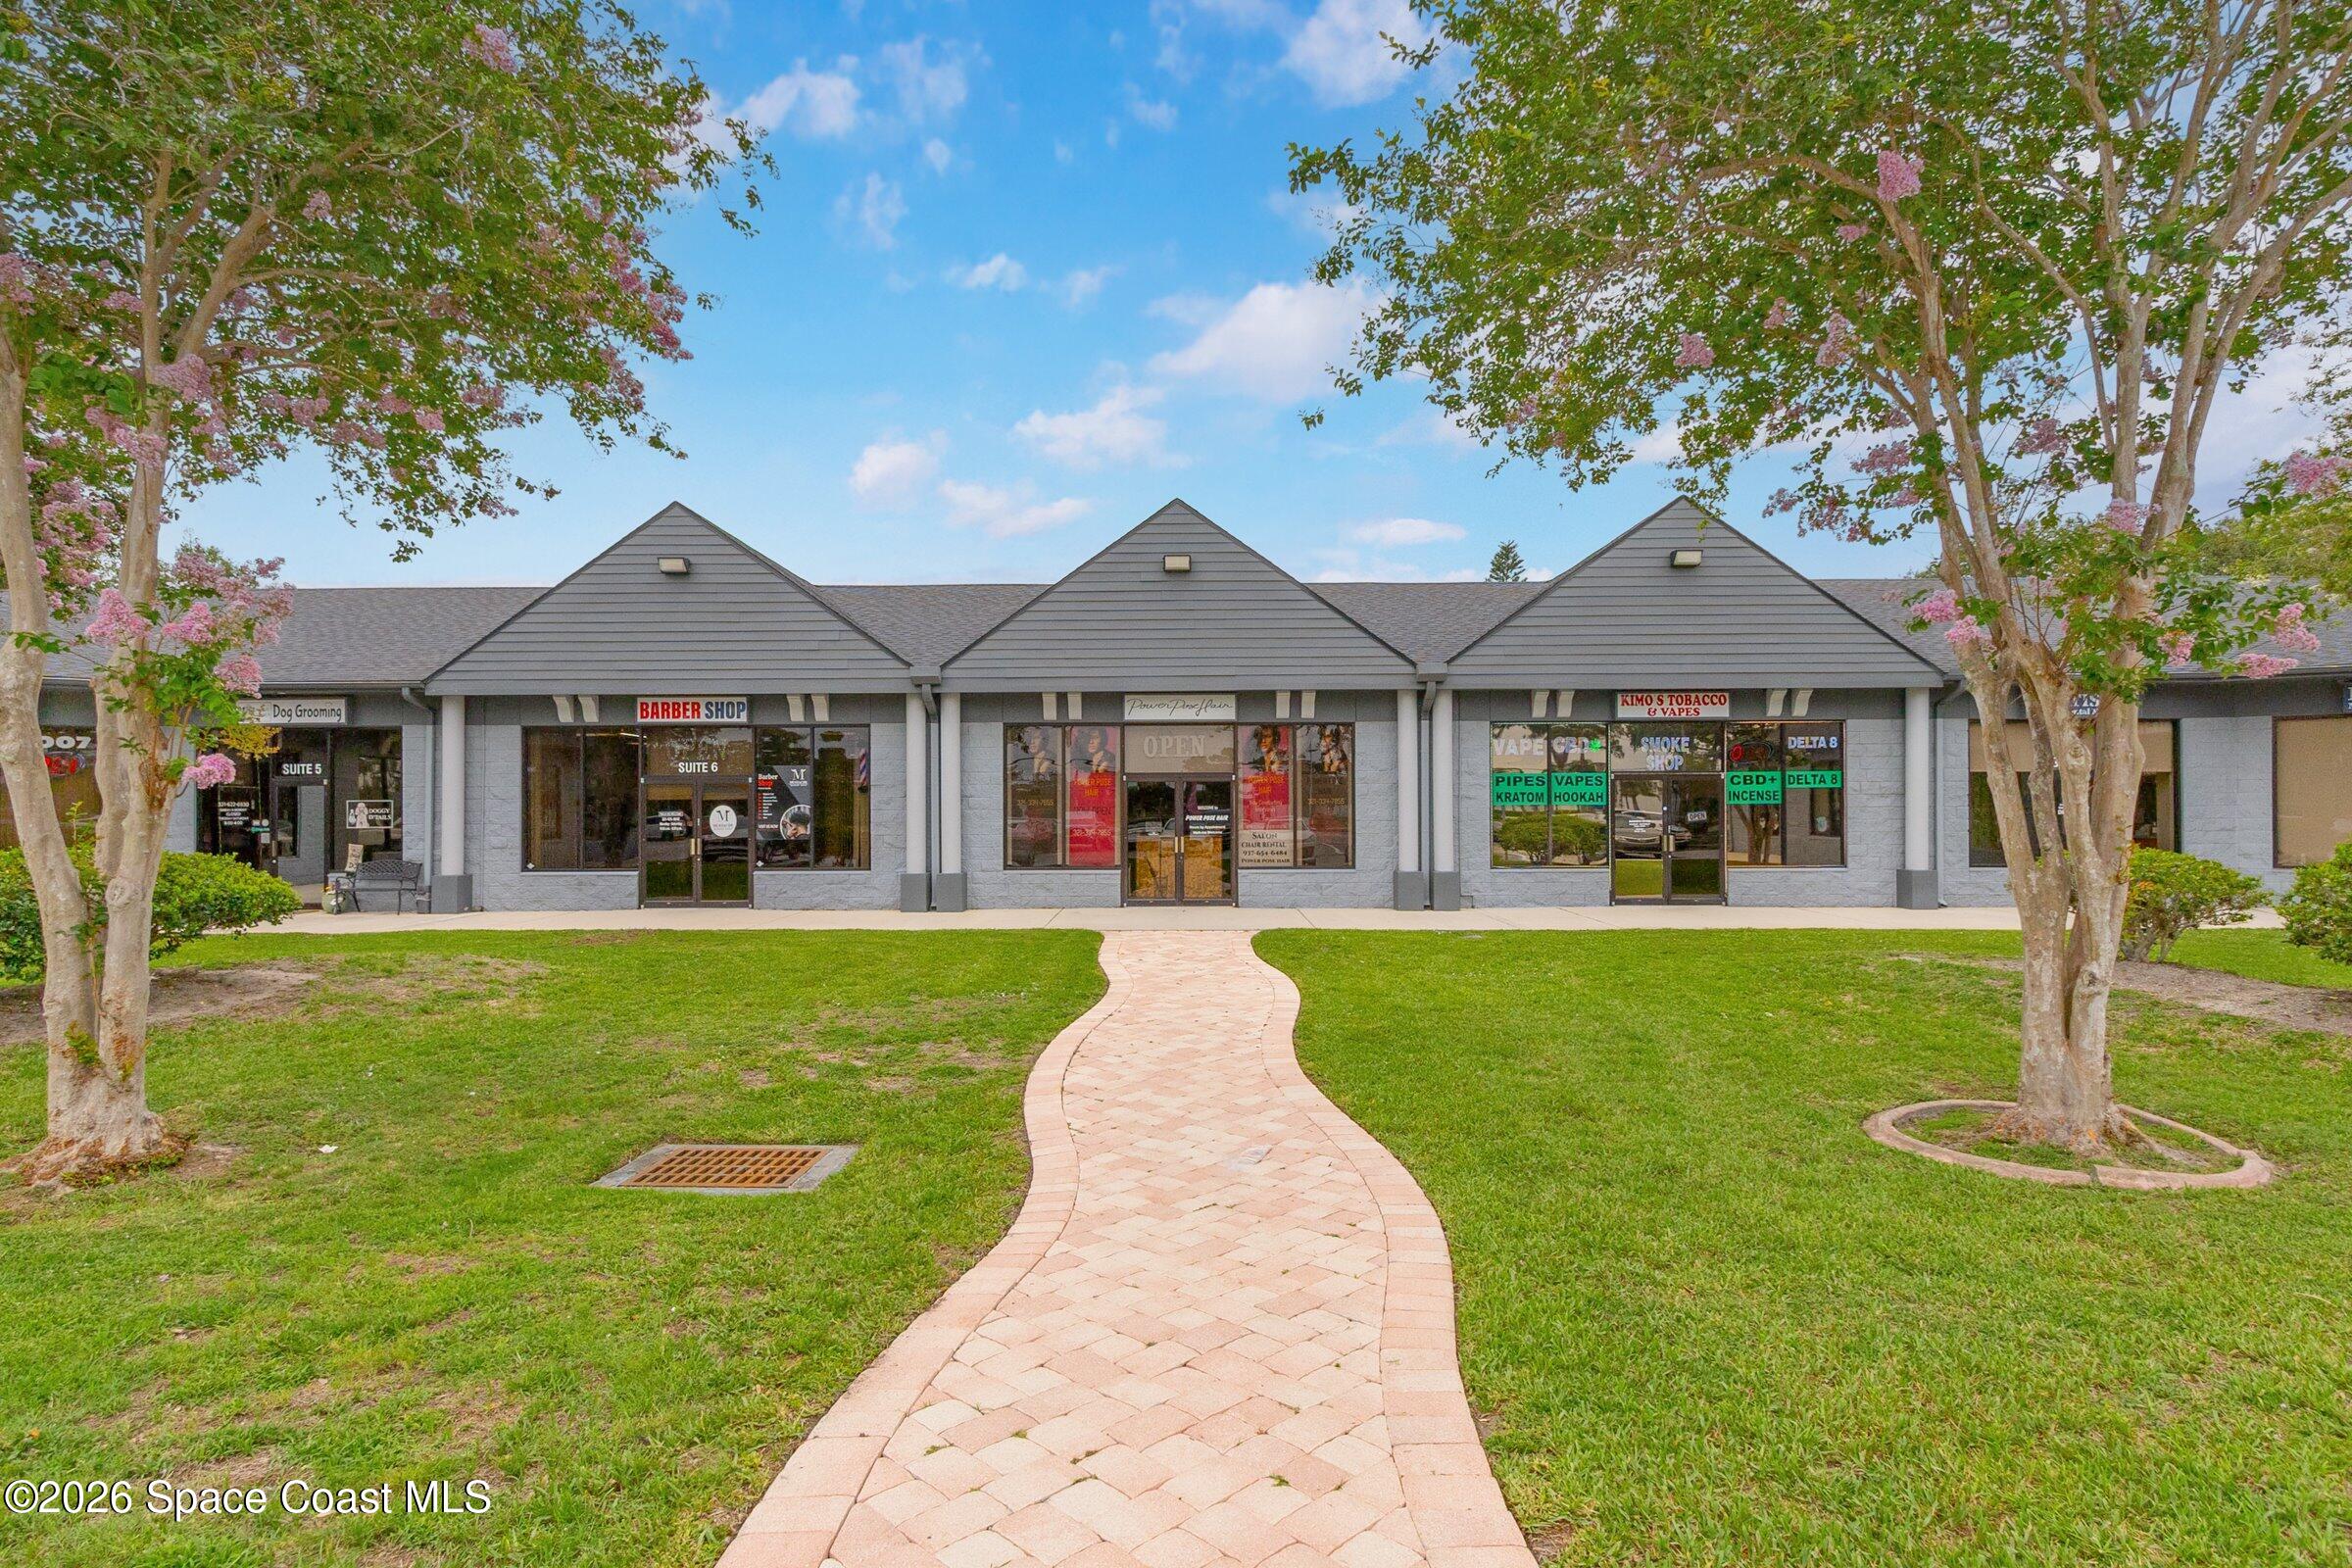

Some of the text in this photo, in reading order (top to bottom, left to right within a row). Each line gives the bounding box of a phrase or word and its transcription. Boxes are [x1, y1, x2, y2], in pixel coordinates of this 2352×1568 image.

[1621, 694, 1653, 706] KIMO
[1667, 694, 1727, 706] TOBACCO
[272, 704, 342, 723] Dog Grooming
[640, 702, 746, 719] BARBER SHOP
[1647, 708, 1700, 716] & VAPES
[1144, 735, 1205, 758] OPEN
[1493, 738, 1544, 756] VAPE
[1552, 736, 1589, 754] CBD
[1641, 737, 1690, 754] SMOKE
[1788, 736, 1838, 749] DELTA 8
[282, 763, 322, 775] SUITE 5
[678, 761, 718, 773] SUITE 6
[1646, 755, 1684, 771] SHOP
[1494, 775, 1546, 786] PIPES
[1554, 775, 1603, 786] VAPES
[1730, 774, 1778, 785] CBD+
[1788, 774, 1838, 784] DELTA 8
[1495, 792, 1544, 803] KRATOM
[1554, 792, 1603, 802] HOOKAH
[1728, 790, 1780, 801] INCENSE
